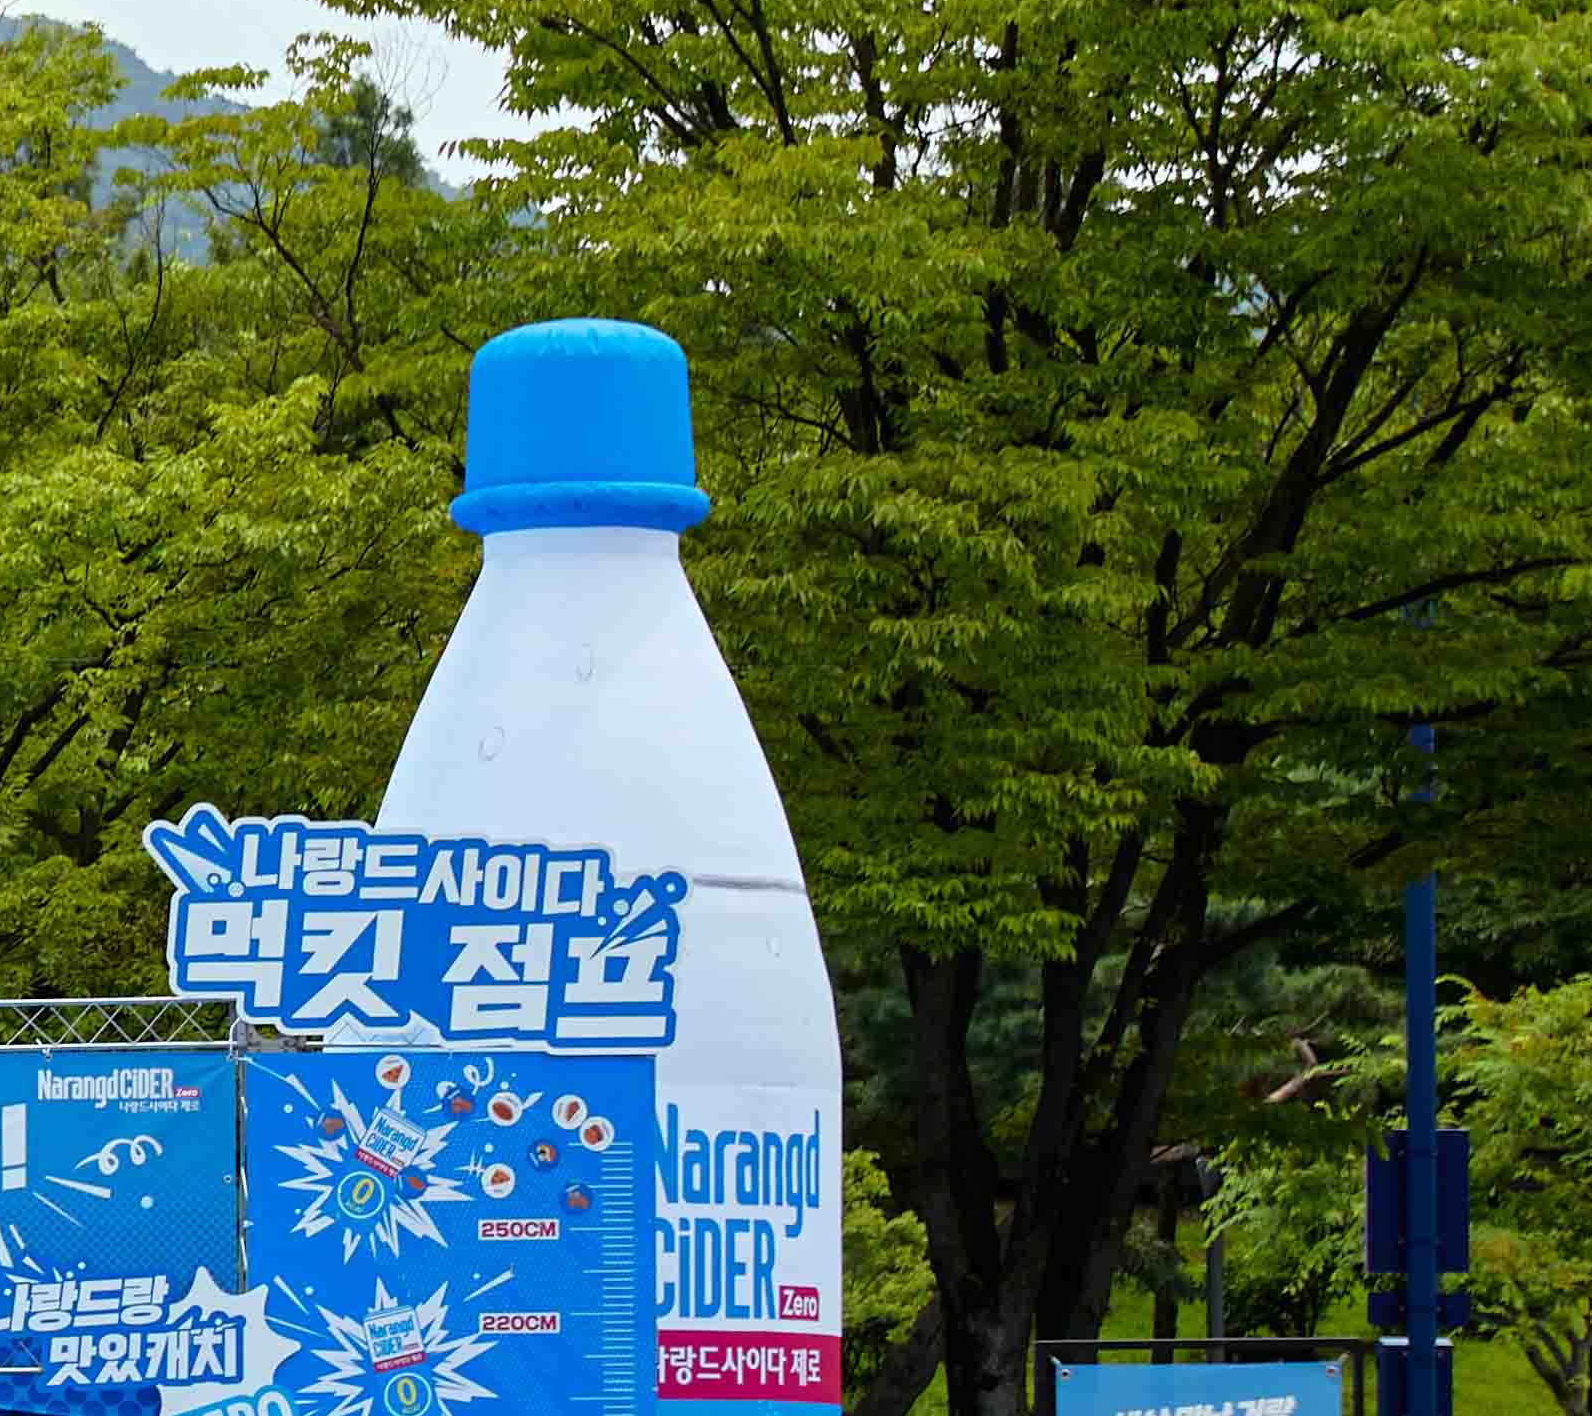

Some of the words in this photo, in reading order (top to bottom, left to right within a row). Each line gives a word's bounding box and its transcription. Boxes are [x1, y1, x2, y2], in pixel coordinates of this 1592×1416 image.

[243, 833, 604, 918] 나랑드사이다
[184, 901, 405, 1019] 먹킷
[442, 924, 669, 1037] 점프
[657, 1103, 820, 1236] Narangd
[353, 1178, 373, 1204] 0
[481, 1222, 557, 1238] 250CM
[783, 1289, 818, 1317] Zero
[482, 1314, 557, 1331] 220CM
[48, 1324, 238, 1383] 맛있캐치
[791, 1352, 820, 1384] 제로
[396, 1377, 416, 1405] 0
